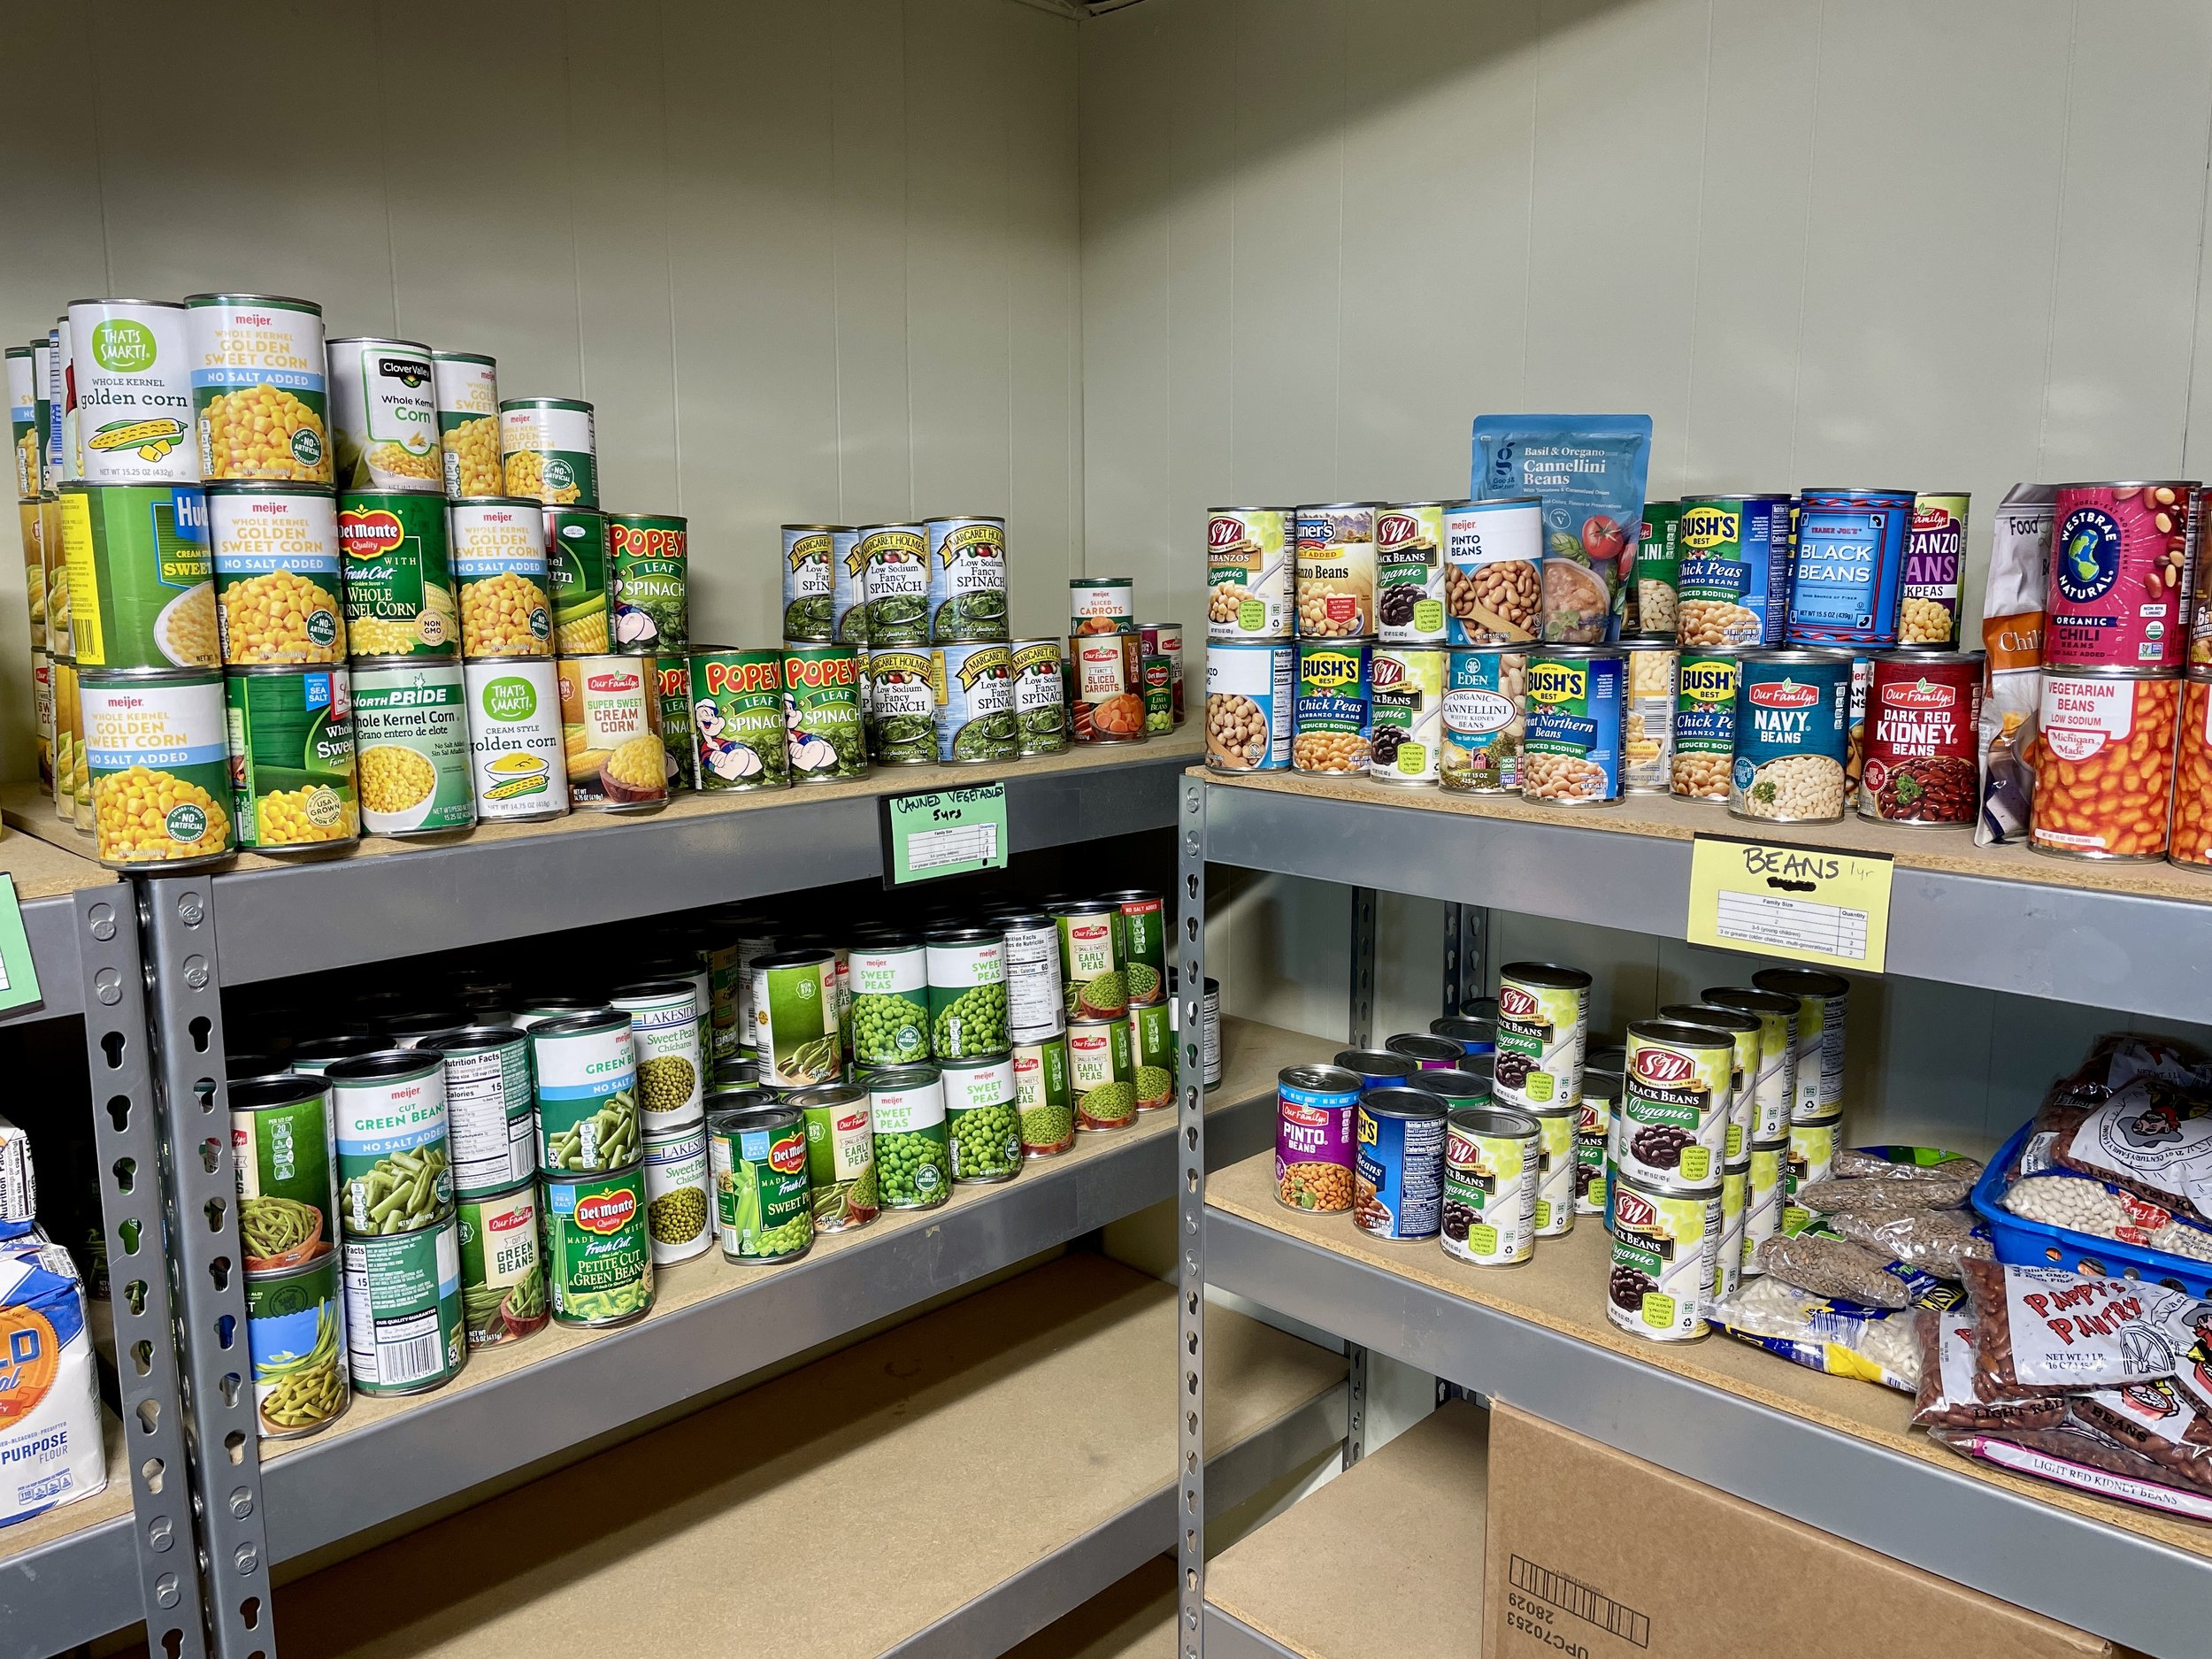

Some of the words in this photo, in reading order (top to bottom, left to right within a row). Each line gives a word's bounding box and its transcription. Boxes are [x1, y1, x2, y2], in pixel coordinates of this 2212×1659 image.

[235, 314, 273, 326] meijer
[214, 330, 247, 339] WHOLE
[250, 331, 294, 341] KERNEL
[100, 344, 147, 359] SMART!
[220, 340, 290, 354] GOLDEN
[204, 353, 257, 366] SWEET
[265, 355, 308, 369] CORN
[383, 362, 411, 373] Clover
[412, 364, 430, 378] Valley
[92, 378, 124, 387] WHOLE
[126, 379, 165, 388] KERNEL
[207, 373, 227, 382] NO
[228, 373, 260, 383] SALT
[265, 373, 308, 386] ADDED
[81, 387, 136, 409] golden
[144, 392, 188, 408] corn
[395, 407, 431, 424] Corn
[1525, 448, 1549, 457] Basil
[1561, 448, 1605, 457] Oregano
[152, 468, 173, 477] (432g)
[1524, 459, 1606, 473] Cannellini
[1452, 520, 1476, 530] meijer
[2009, 516, 2039, 535] Food
[2062, 512, 2116, 541] WESTBRAE
[236, 527, 306, 539] GOLDEN
[222, 541, 276, 553] SWEET
[280, 541, 323, 553] CORN
[864, 536, 895, 554] MARGARET
[895, 535, 924, 552] HOLMES
[1452, 535, 1480, 546] PINTO
[1801, 544, 1873, 563] BLACK
[225, 559, 242, 569] NO
[245, 559, 277, 569] SALT
[281, 559, 323, 569] ADDED
[458, 564, 474, 572] NO
[477, 563, 504, 572] SALT
[509, 563, 540, 572] ADDED
[644, 563, 674, 573] LEAF
[879, 573, 906, 582] Fancy
[972, 567, 996, 576] Fancy
[1798, 565, 1870, 582] BEANS
[626, 581, 686, 597] SPINACH
[869, 580, 922, 594] SPINACH
[2059, 575, 2113, 599] NATURAL
[1836, 611, 1853, 620] (439g)
[2056, 617, 2107, 626] ORGANIC
[2059, 627, 2100, 641] CHILI
[1302, 660, 1356, 679] BUSH'S
[1458, 673, 1487, 686] EDEN
[1085, 683, 1119, 693] CARROTS
[2048, 681, 2115, 698] VEGETARIAN
[744, 697, 773, 709] LEAF
[821, 691, 850, 701] LEAF
[1453, 694, 1492, 703] ORGANIC
[1886, 688, 1906, 700] Our
[1907, 689, 1950, 706] Family
[588, 700, 613, 710] SUPER
[617, 698, 642, 707] SWEET
[1299, 700, 1330, 712] Chick
[1333, 699, 1362, 712] Peas
[1443, 703, 1507, 715] CANNELLINI
[2057, 699, 2095, 712] BEANS
[595, 708, 638, 721] CREAM
[1755, 710, 1810, 731] NAVY
[1885, 710, 1916, 723] DARK
[1924, 711, 1951, 724] RED
[2051, 714, 2066, 723] LOW
[2068, 715, 2101, 726] SODIUM
[96, 722, 165, 735] GOLDEN
[357, 730, 382, 740] Grano
[384, 729, 410, 739] entero
[429, 726, 448, 735] elote
[1877, 721, 1956, 745] KIDNEY
[2050, 732, 2095, 745] Michigan
[1893, 743, 1935, 757] BEANS
[311, 803, 340, 816] GROWN
[317, 799, 332, 808] USA
[897, 795, 941, 814] CANNED
[1743, 847, 1839, 879] BEANS
[1842, 910, 1866, 919] Quantity
[1779, 929, 1801, 938] children)
[1786, 940, 1832, 952] multi-generational)
[1079, 952, 1104, 963] EARLY
[864, 980, 891, 989] PEAS
[647, 1033, 679, 1046] Sweet
[680, 1028, 695, 1039] Peas
[585, 1058, 625, 1075] GREEN
[1078, 1063, 1103, 1073] EARLY
[398, 1103, 416, 1113] CUT
[1283, 1121, 1325, 1145] PINTO
[580, 1207, 599, 1220] Del
[601, 1199, 634, 1215] Monte
[497, 1240, 533, 1263] GREEN
[578, 1257, 617, 1274] PETITE
[619, 1249, 641, 1265] CUT
[2023, 1281, 2126, 1318] PAPPY'S
[388, 1315, 409, 1325] QUALITY
[409, 1308, 436, 1321] GUARANTEE
[2047, 1296, 2142, 1346] PANTRY
[1974, 1405, 2024, 1419] LIGHT
[2032, 1398, 2065, 1415] RED
[1, 1431, 68, 1464] PURPOSE
[39, 1445, 68, 1464] FLOUR
[2033, 1458, 2067, 1479] LIGHT
[2070, 1471, 2092, 1482] RED
[2094, 1476, 2138, 1498] KIDNEY
[2139, 1486, 2177, 1505] BEANS
[1509, 1593, 1555, 1625] 28029
[1507, 1611, 1588, 1659] UPC70253
